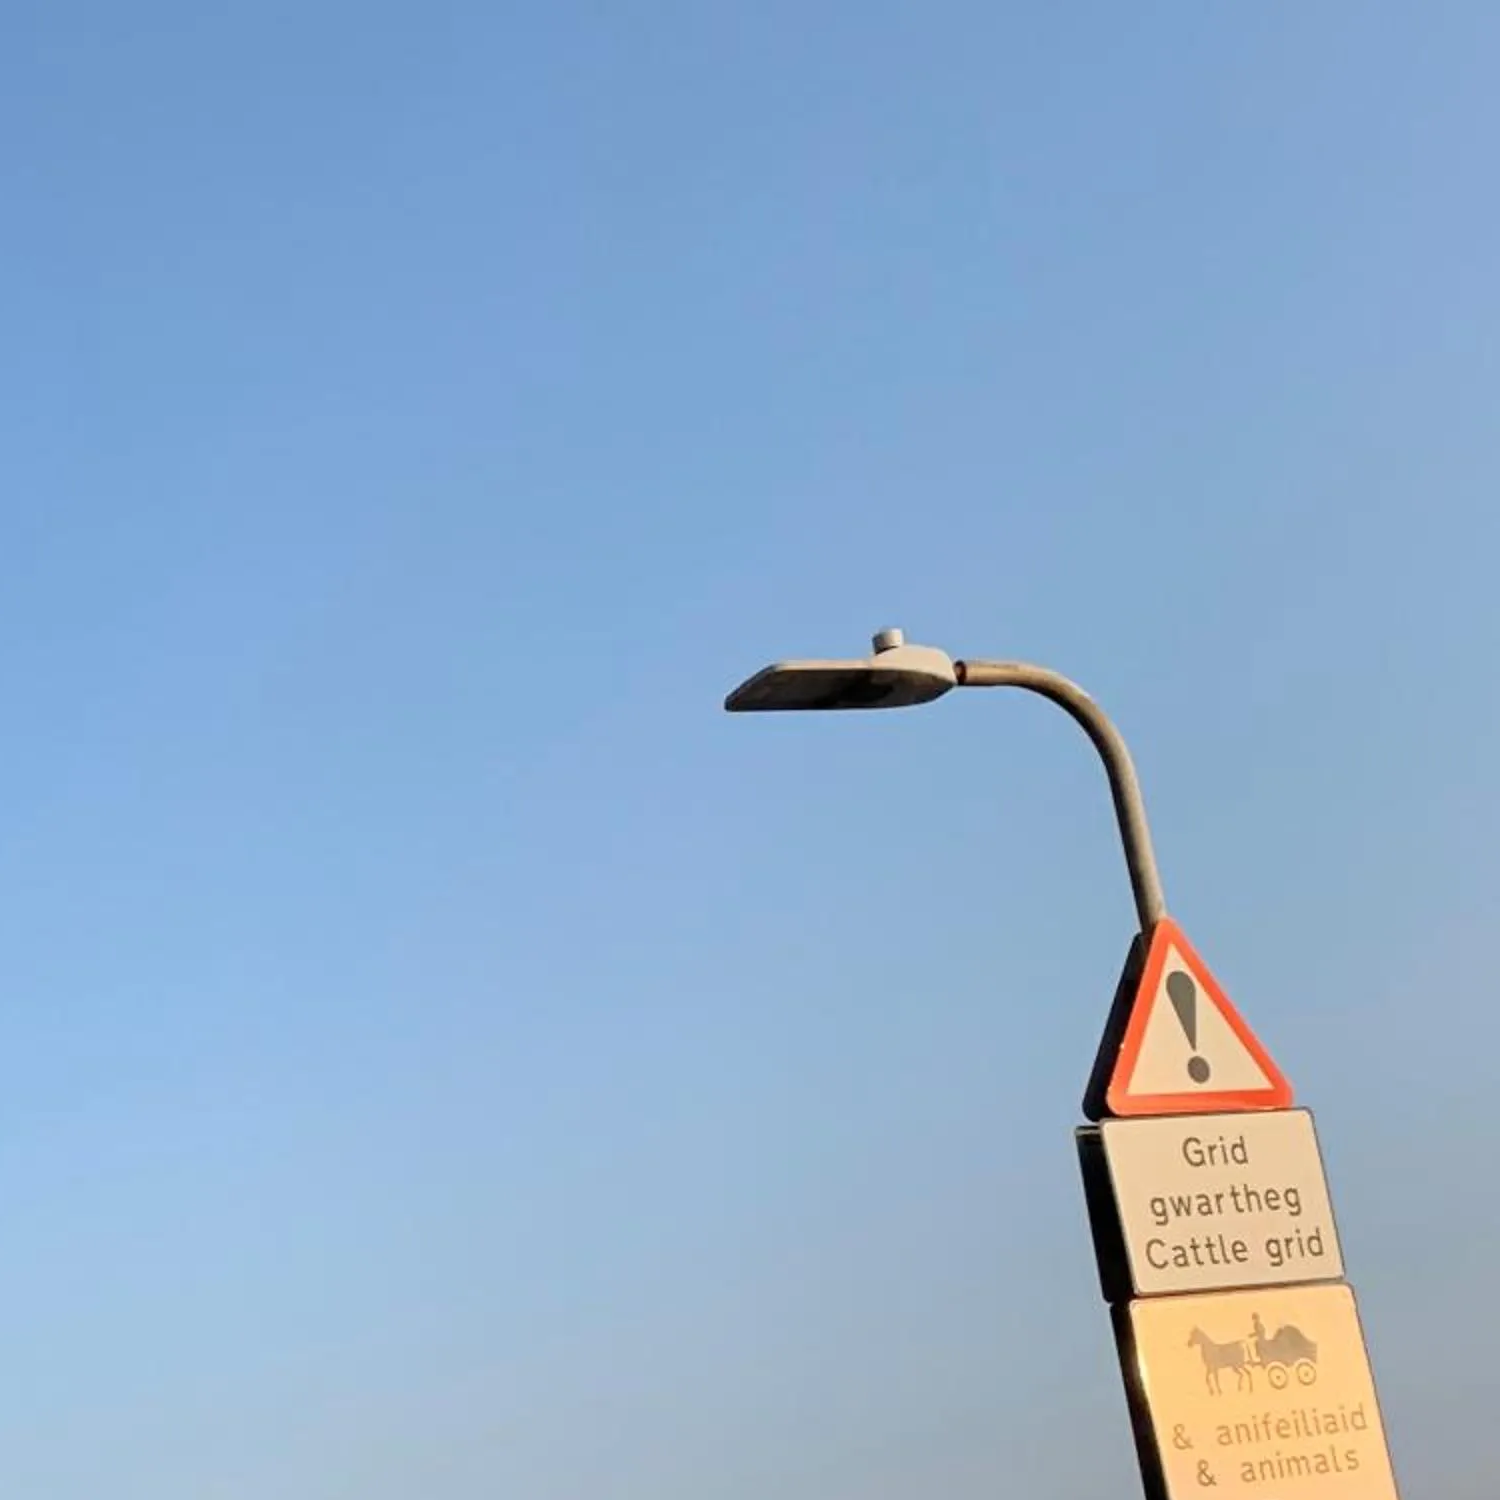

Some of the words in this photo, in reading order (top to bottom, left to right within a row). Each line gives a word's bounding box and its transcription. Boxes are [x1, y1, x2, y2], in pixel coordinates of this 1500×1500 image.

[1182, 1135, 1249, 1168] Grid
[1150, 1183, 1301, 1226] gwartheg
[1145, 1236, 1249, 1270] Cattle
[1265, 1228, 1325, 1267] grid
[1172, 1423, 1195, 1450] &
[1216, 1403, 1368, 1446] anifeiliaid
[1196, 1459, 1217, 1486] &
[1240, 1446, 1360, 1484] animals
